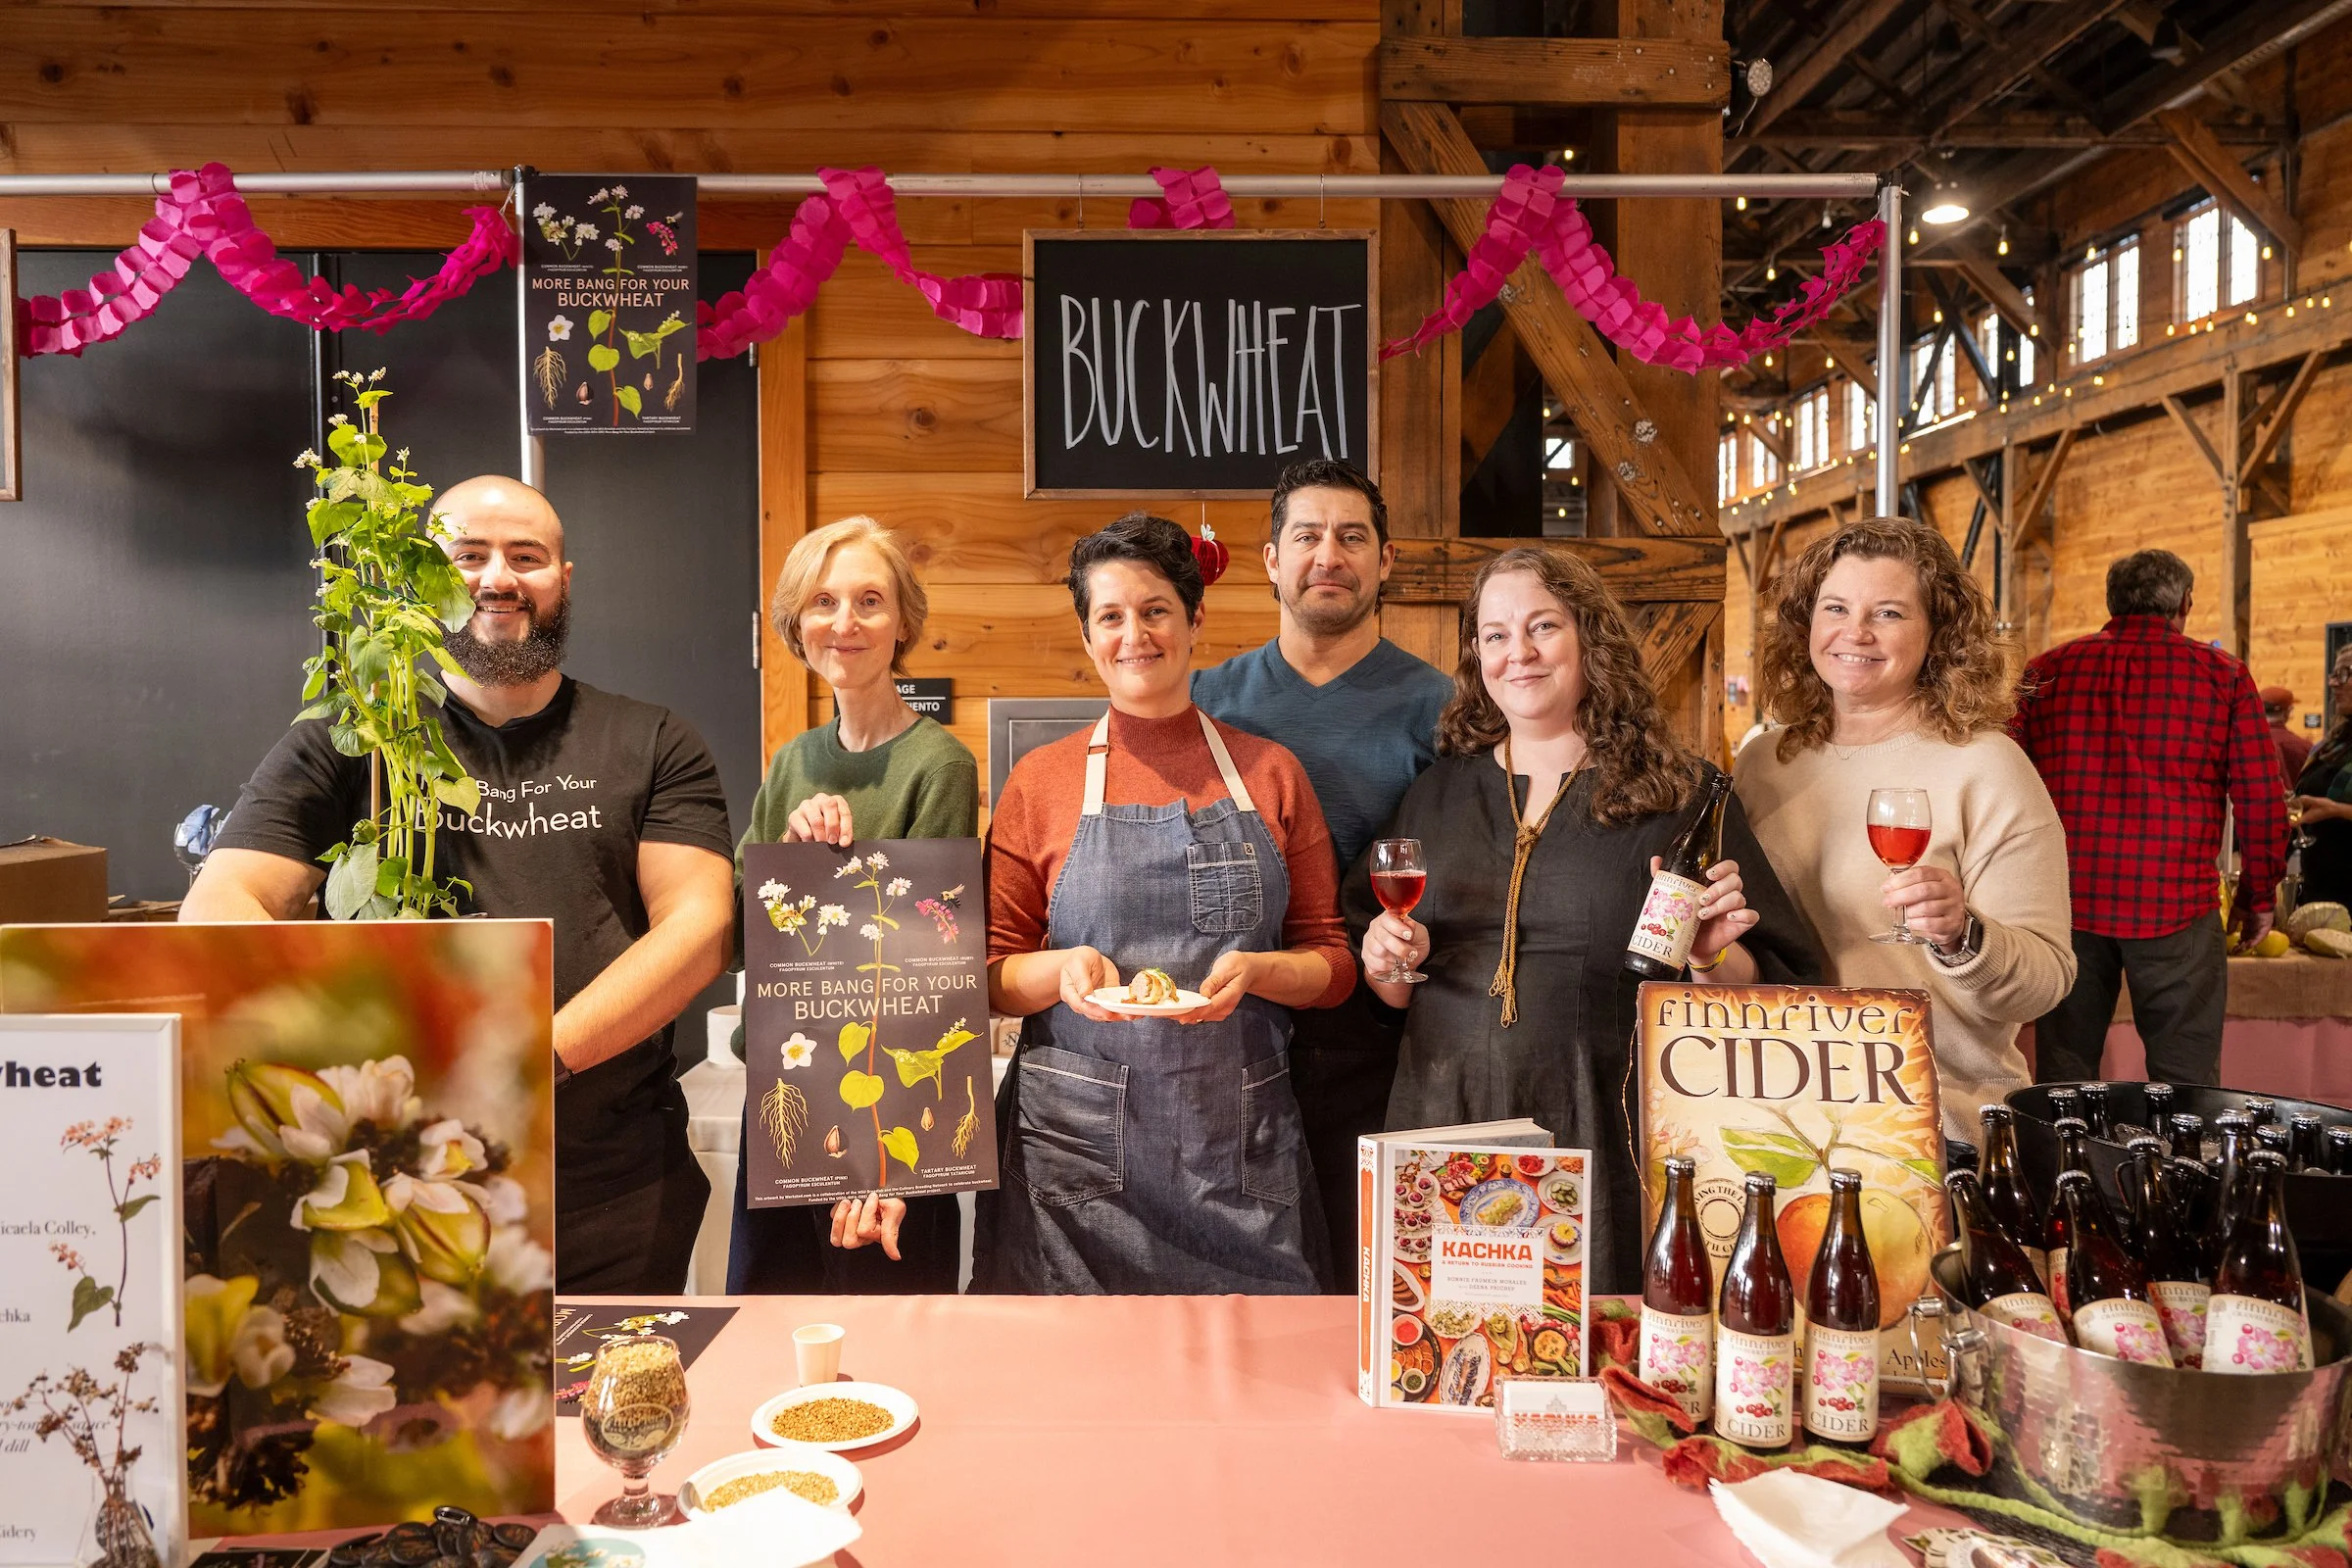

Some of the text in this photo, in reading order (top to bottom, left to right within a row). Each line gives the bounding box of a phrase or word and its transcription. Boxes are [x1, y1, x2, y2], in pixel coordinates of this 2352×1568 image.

[532, 278, 690, 290] MORE BANG FOR YOUR
[558, 292, 664, 307] BUCKWHEAT
[1060, 294, 1363, 462] BUCKWHEAT
[475, 774, 597, 804] Bang For Your
[415, 796, 603, 840] Buckwheat
[1632, 935, 1673, 958] CIDER
[758, 974, 977, 998] MORE BANG FOR YOUR
[795, 995, 943, 1020] BUCKWHEAT
[1656, 991, 1915, 1035] finnriver
[0, 1060, 101, 1087] heat
[1659, 1035, 1917, 1105] CIDER
[1717, 1186, 1739, 1199] THE
[1443, 1241, 1533, 1261] KACHKA
[1362, 1246, 1371, 1302] KACHKA
[1728, 1418, 1787, 1439] CIDER
[1811, 1411, 1870, 1433] CIDER
[5, 1439, 30, 1452] dill
